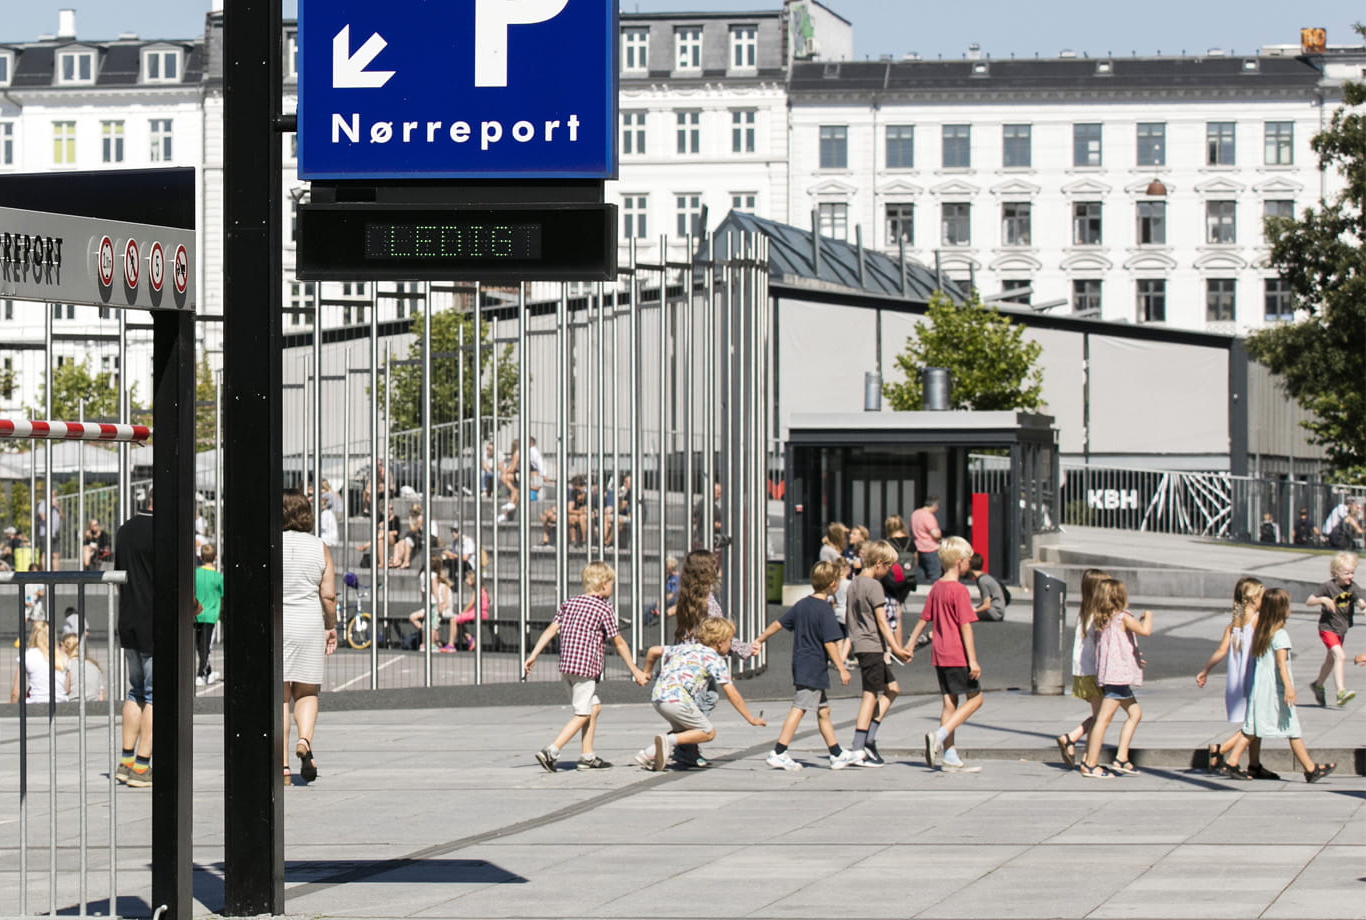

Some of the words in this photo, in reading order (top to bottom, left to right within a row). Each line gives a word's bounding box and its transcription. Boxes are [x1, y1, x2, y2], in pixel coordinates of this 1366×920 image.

[474, 0, 570, 87] P
[331, 113, 580, 150] Nørreport
[390, 225, 513, 257] LEDIG
[1087, 488, 1138, 510] KBH
